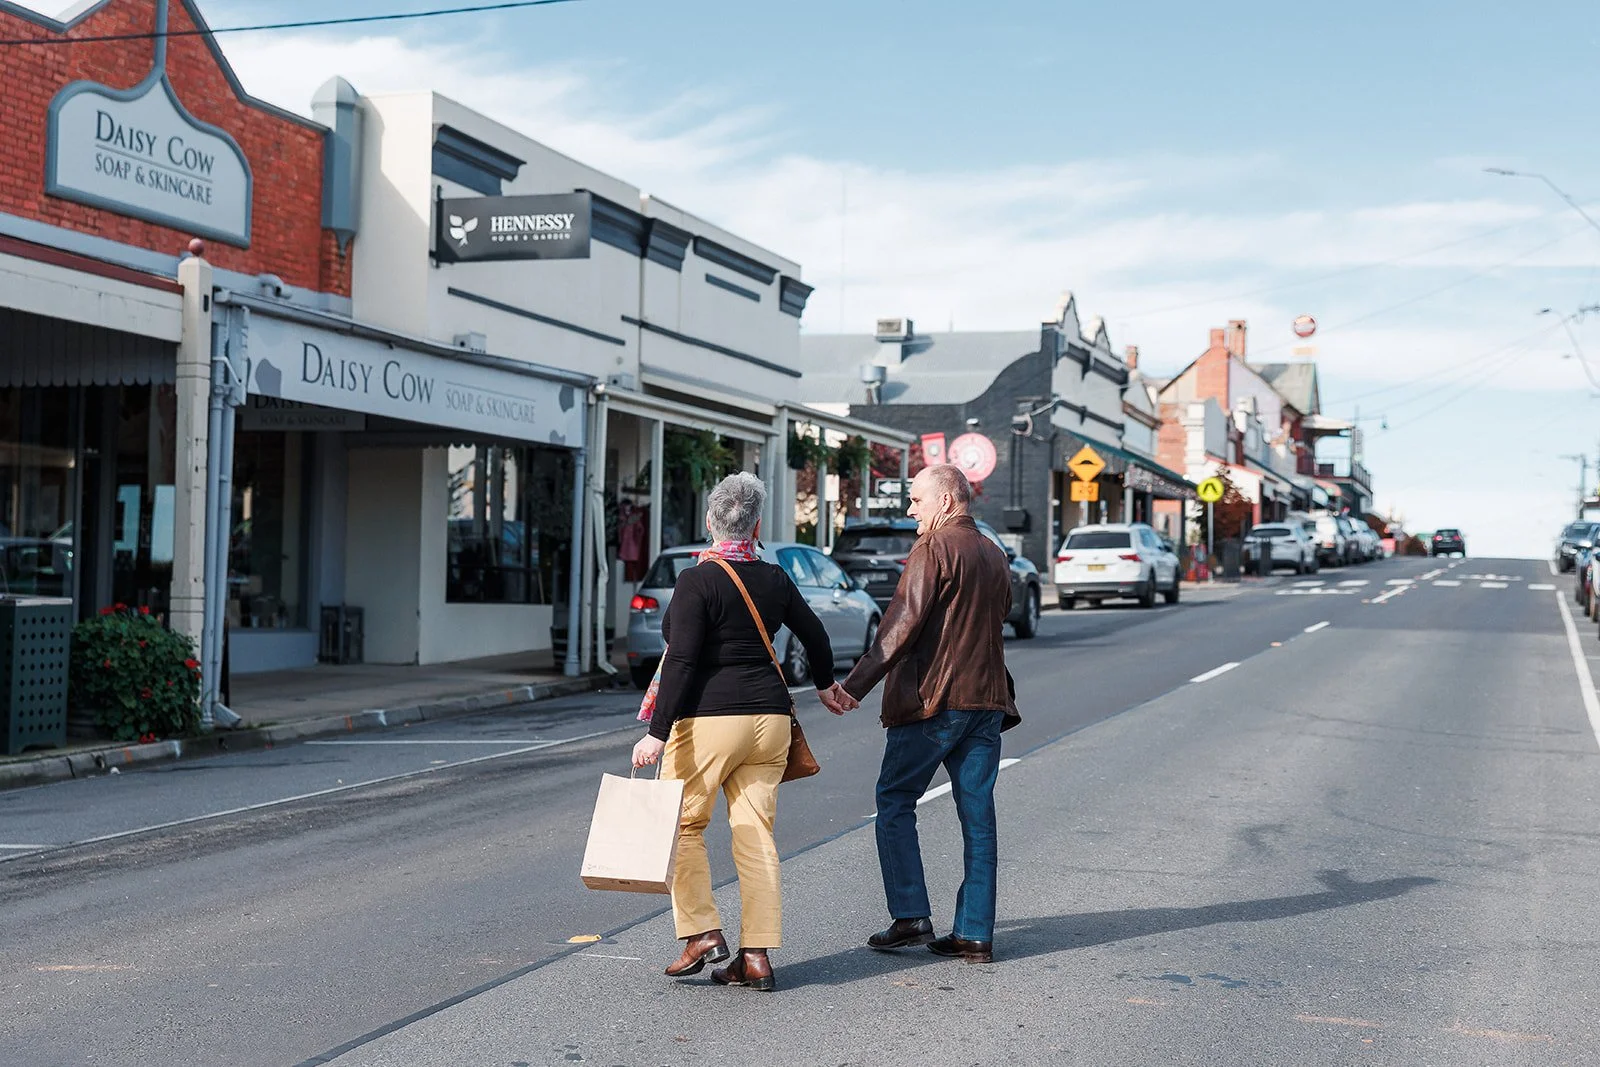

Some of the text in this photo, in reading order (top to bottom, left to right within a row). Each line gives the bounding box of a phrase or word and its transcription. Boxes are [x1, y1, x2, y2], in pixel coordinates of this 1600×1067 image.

[96, 110, 214, 175] DAISY COW
[95, 153, 212, 205] SOAP & SKINCARE
[491, 214, 575, 232] HENNESSY
[301, 341, 434, 404] DAISY COW
[445, 388, 536, 424] SOAP & SKINCARE
